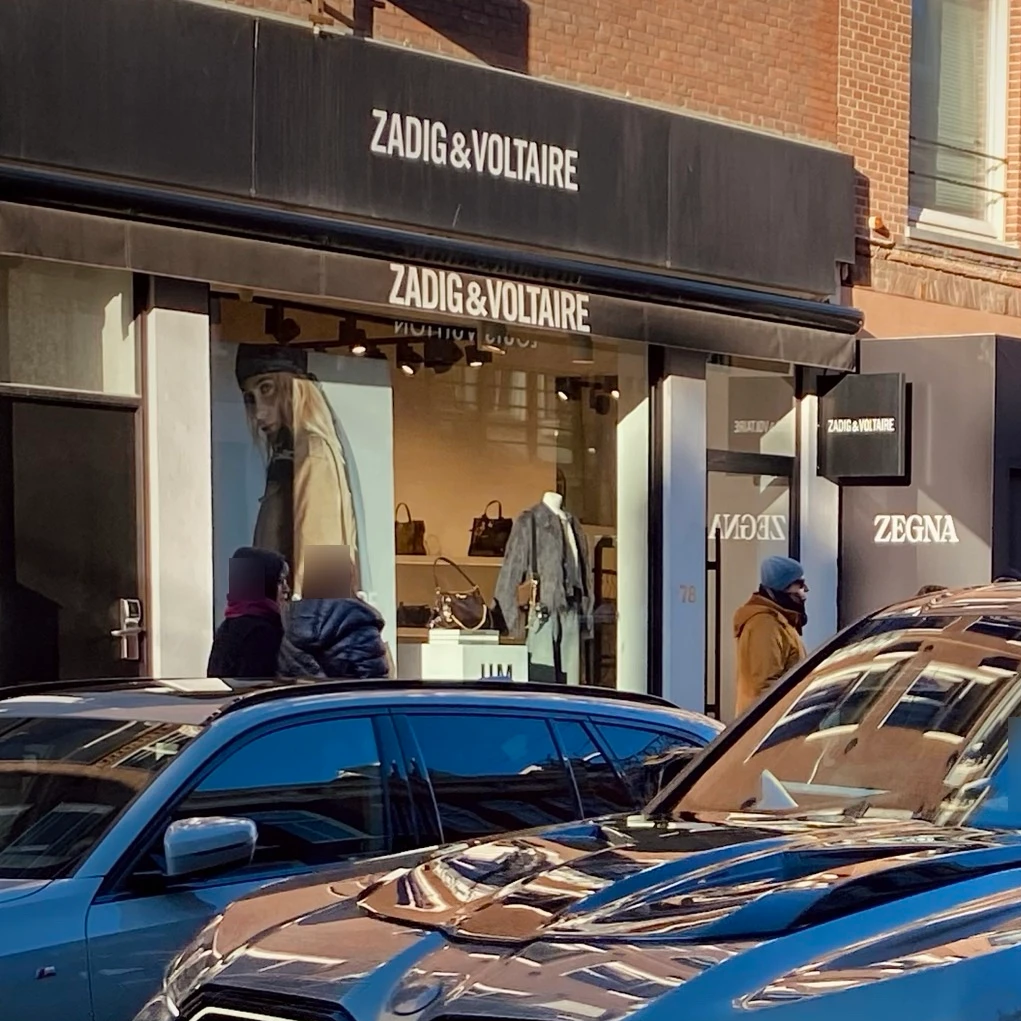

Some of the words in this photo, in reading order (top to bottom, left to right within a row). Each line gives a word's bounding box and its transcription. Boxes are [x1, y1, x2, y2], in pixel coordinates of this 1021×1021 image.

[370, 108, 580, 192] ZADIG&VOLTAIRE
[388, 262, 592, 334] ZADIG&VOLTAIRE
[827, 417, 896, 433] ZADIG&VOLTAIRE
[873, 514, 960, 543] ZEGNA
[679, 584, 697, 604] 78
